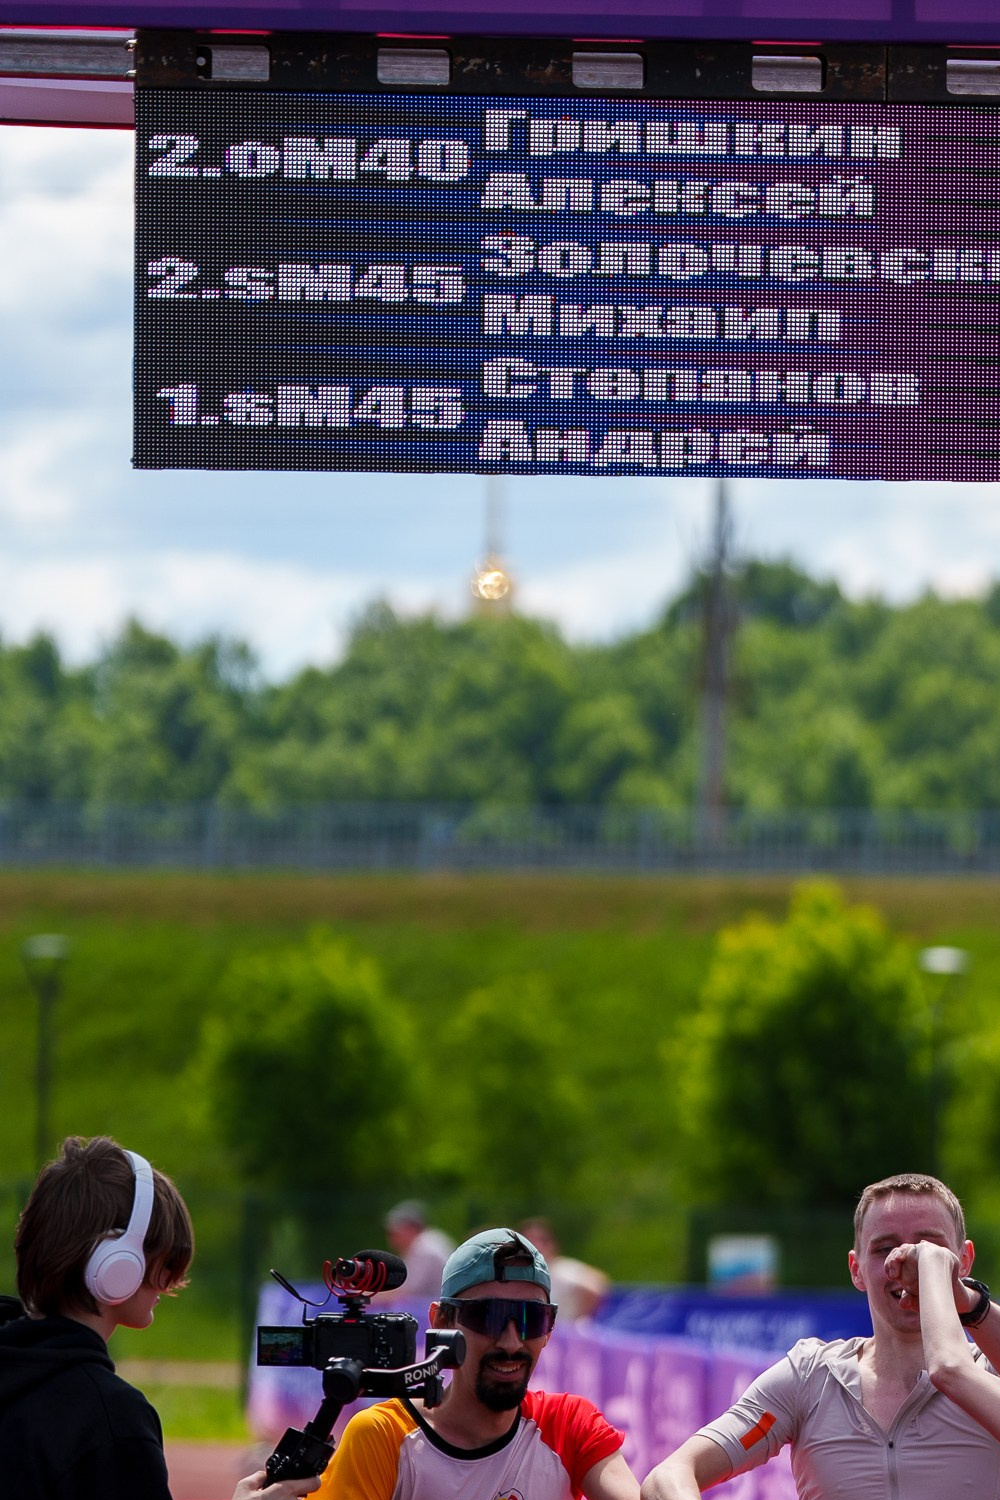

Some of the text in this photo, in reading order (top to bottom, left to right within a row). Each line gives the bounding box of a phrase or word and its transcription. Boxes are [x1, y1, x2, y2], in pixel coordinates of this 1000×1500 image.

[485, 109, 902, 159] Гришкин
[480, 172, 876, 219] Алексей
[483, 293, 842, 341] Михаил
[482, 356, 922, 405] Степанов
[478, 419, 831, 468] Андрей
[404, 1362, 438, 1384] RONIN
